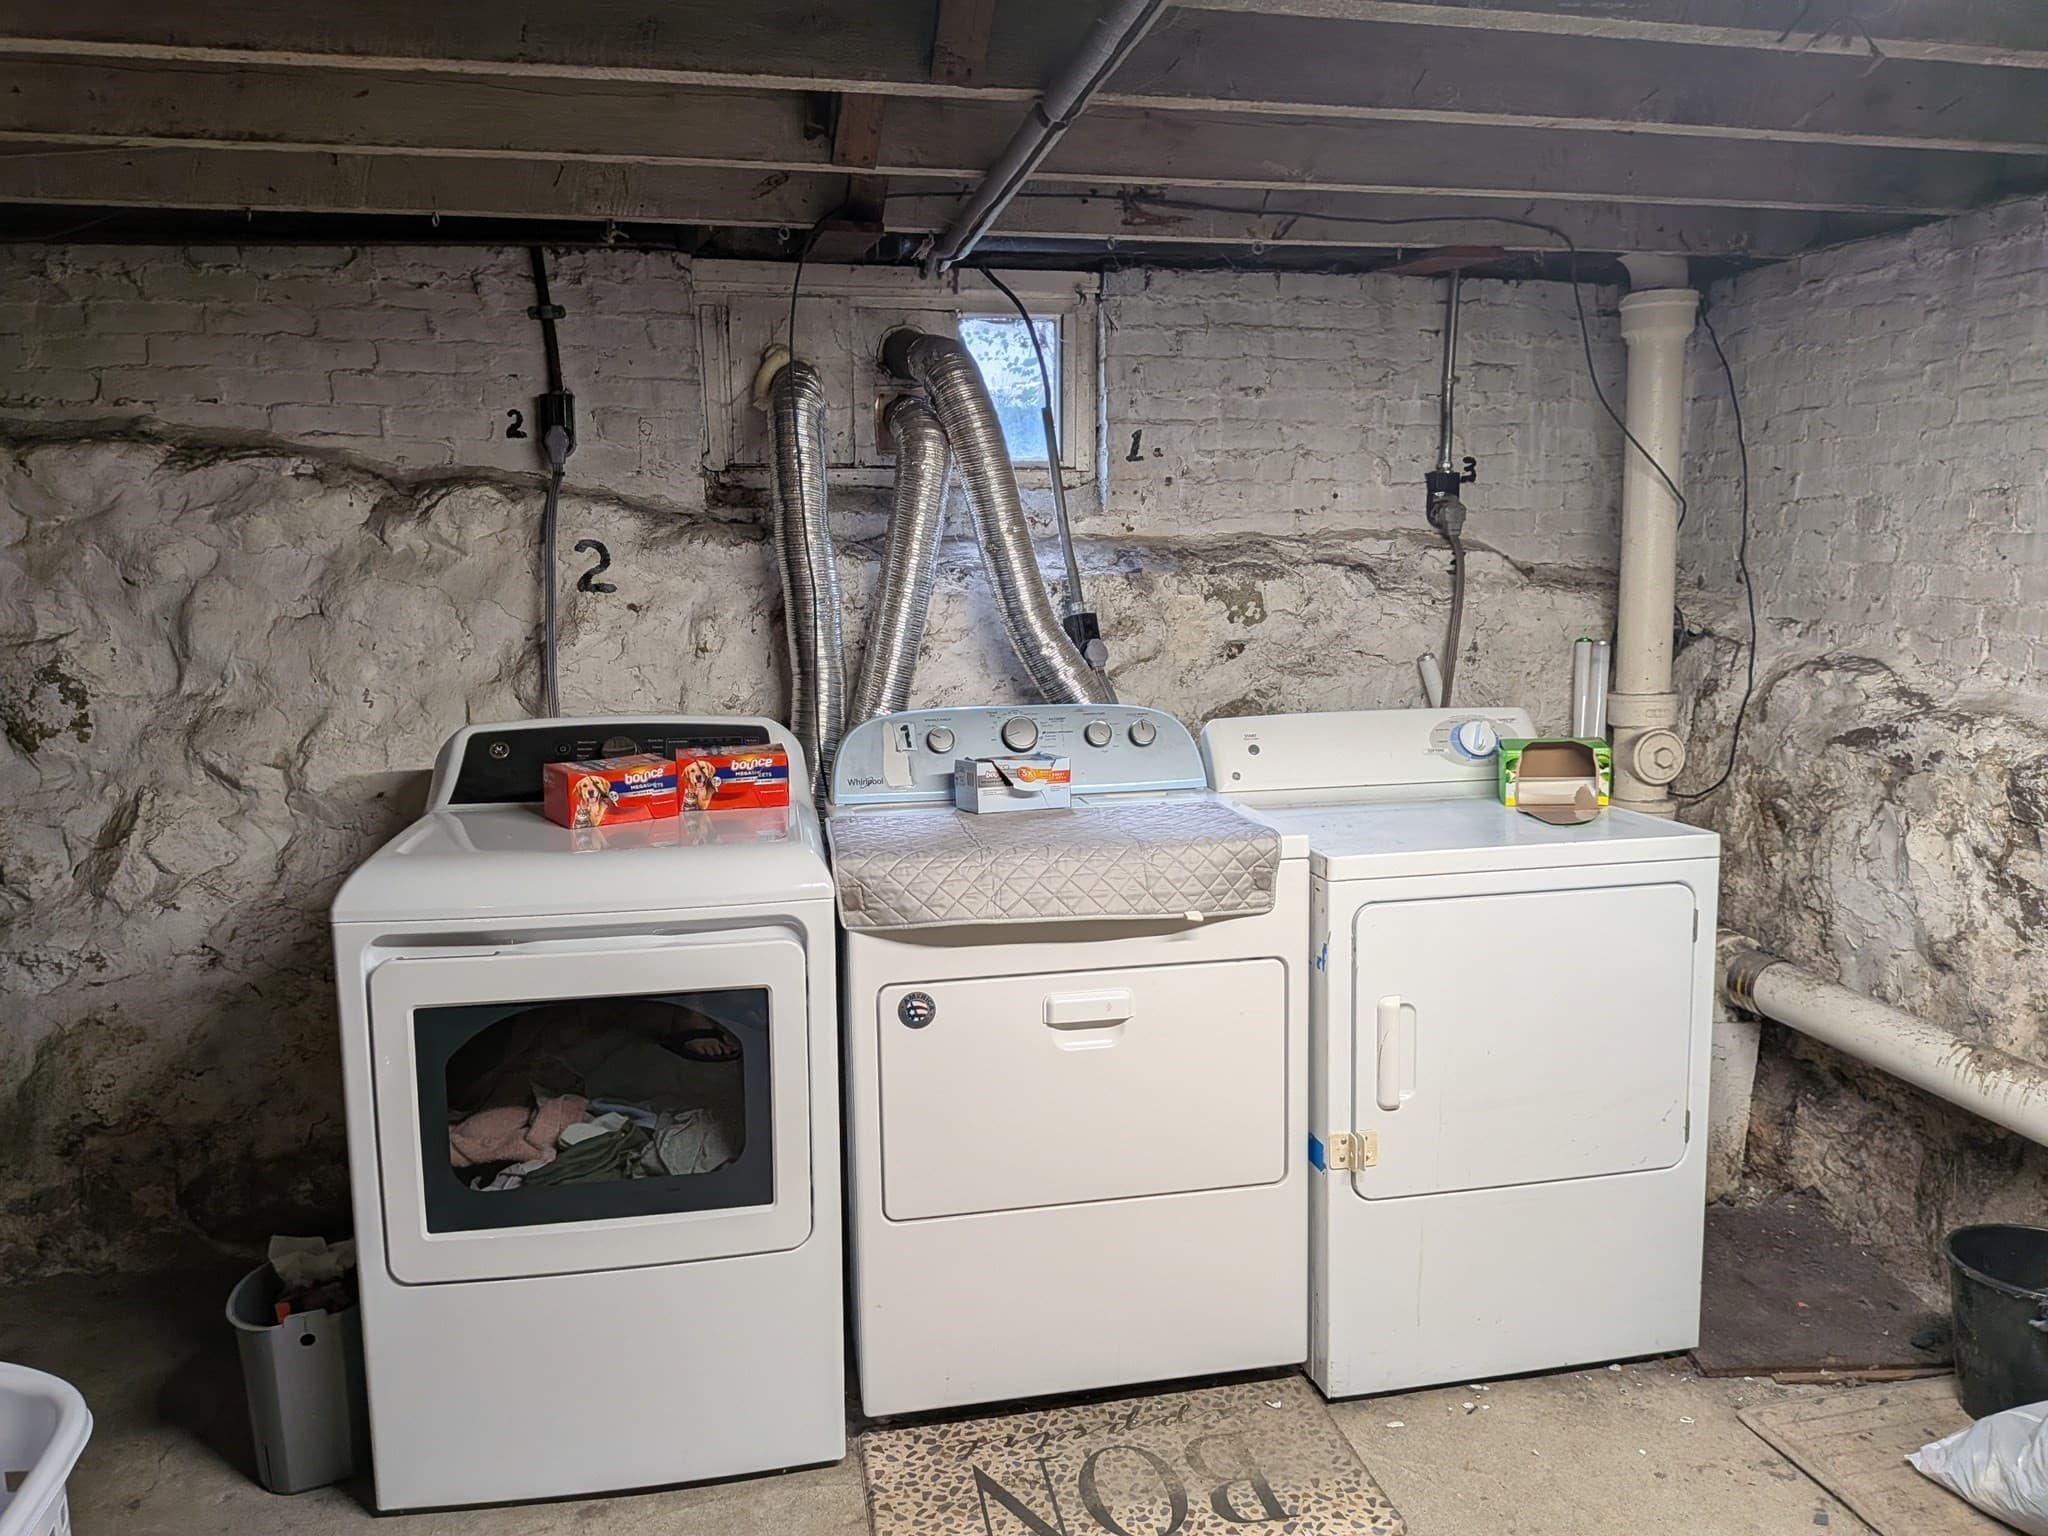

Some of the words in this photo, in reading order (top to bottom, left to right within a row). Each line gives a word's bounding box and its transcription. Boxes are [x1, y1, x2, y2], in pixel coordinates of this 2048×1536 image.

[506, 409, 527, 438] 2
[1126, 429, 1144, 462] 1
[1461, 456, 1476, 483] 3
[574, 539, 617, 593] 2
[900, 724, 912, 748] 1
[625, 767, 664, 785] bounce
[731, 758, 773, 771] bounce
[847, 777, 884, 789] Whirlpool
[970, 1431, 1300, 1536] BON
